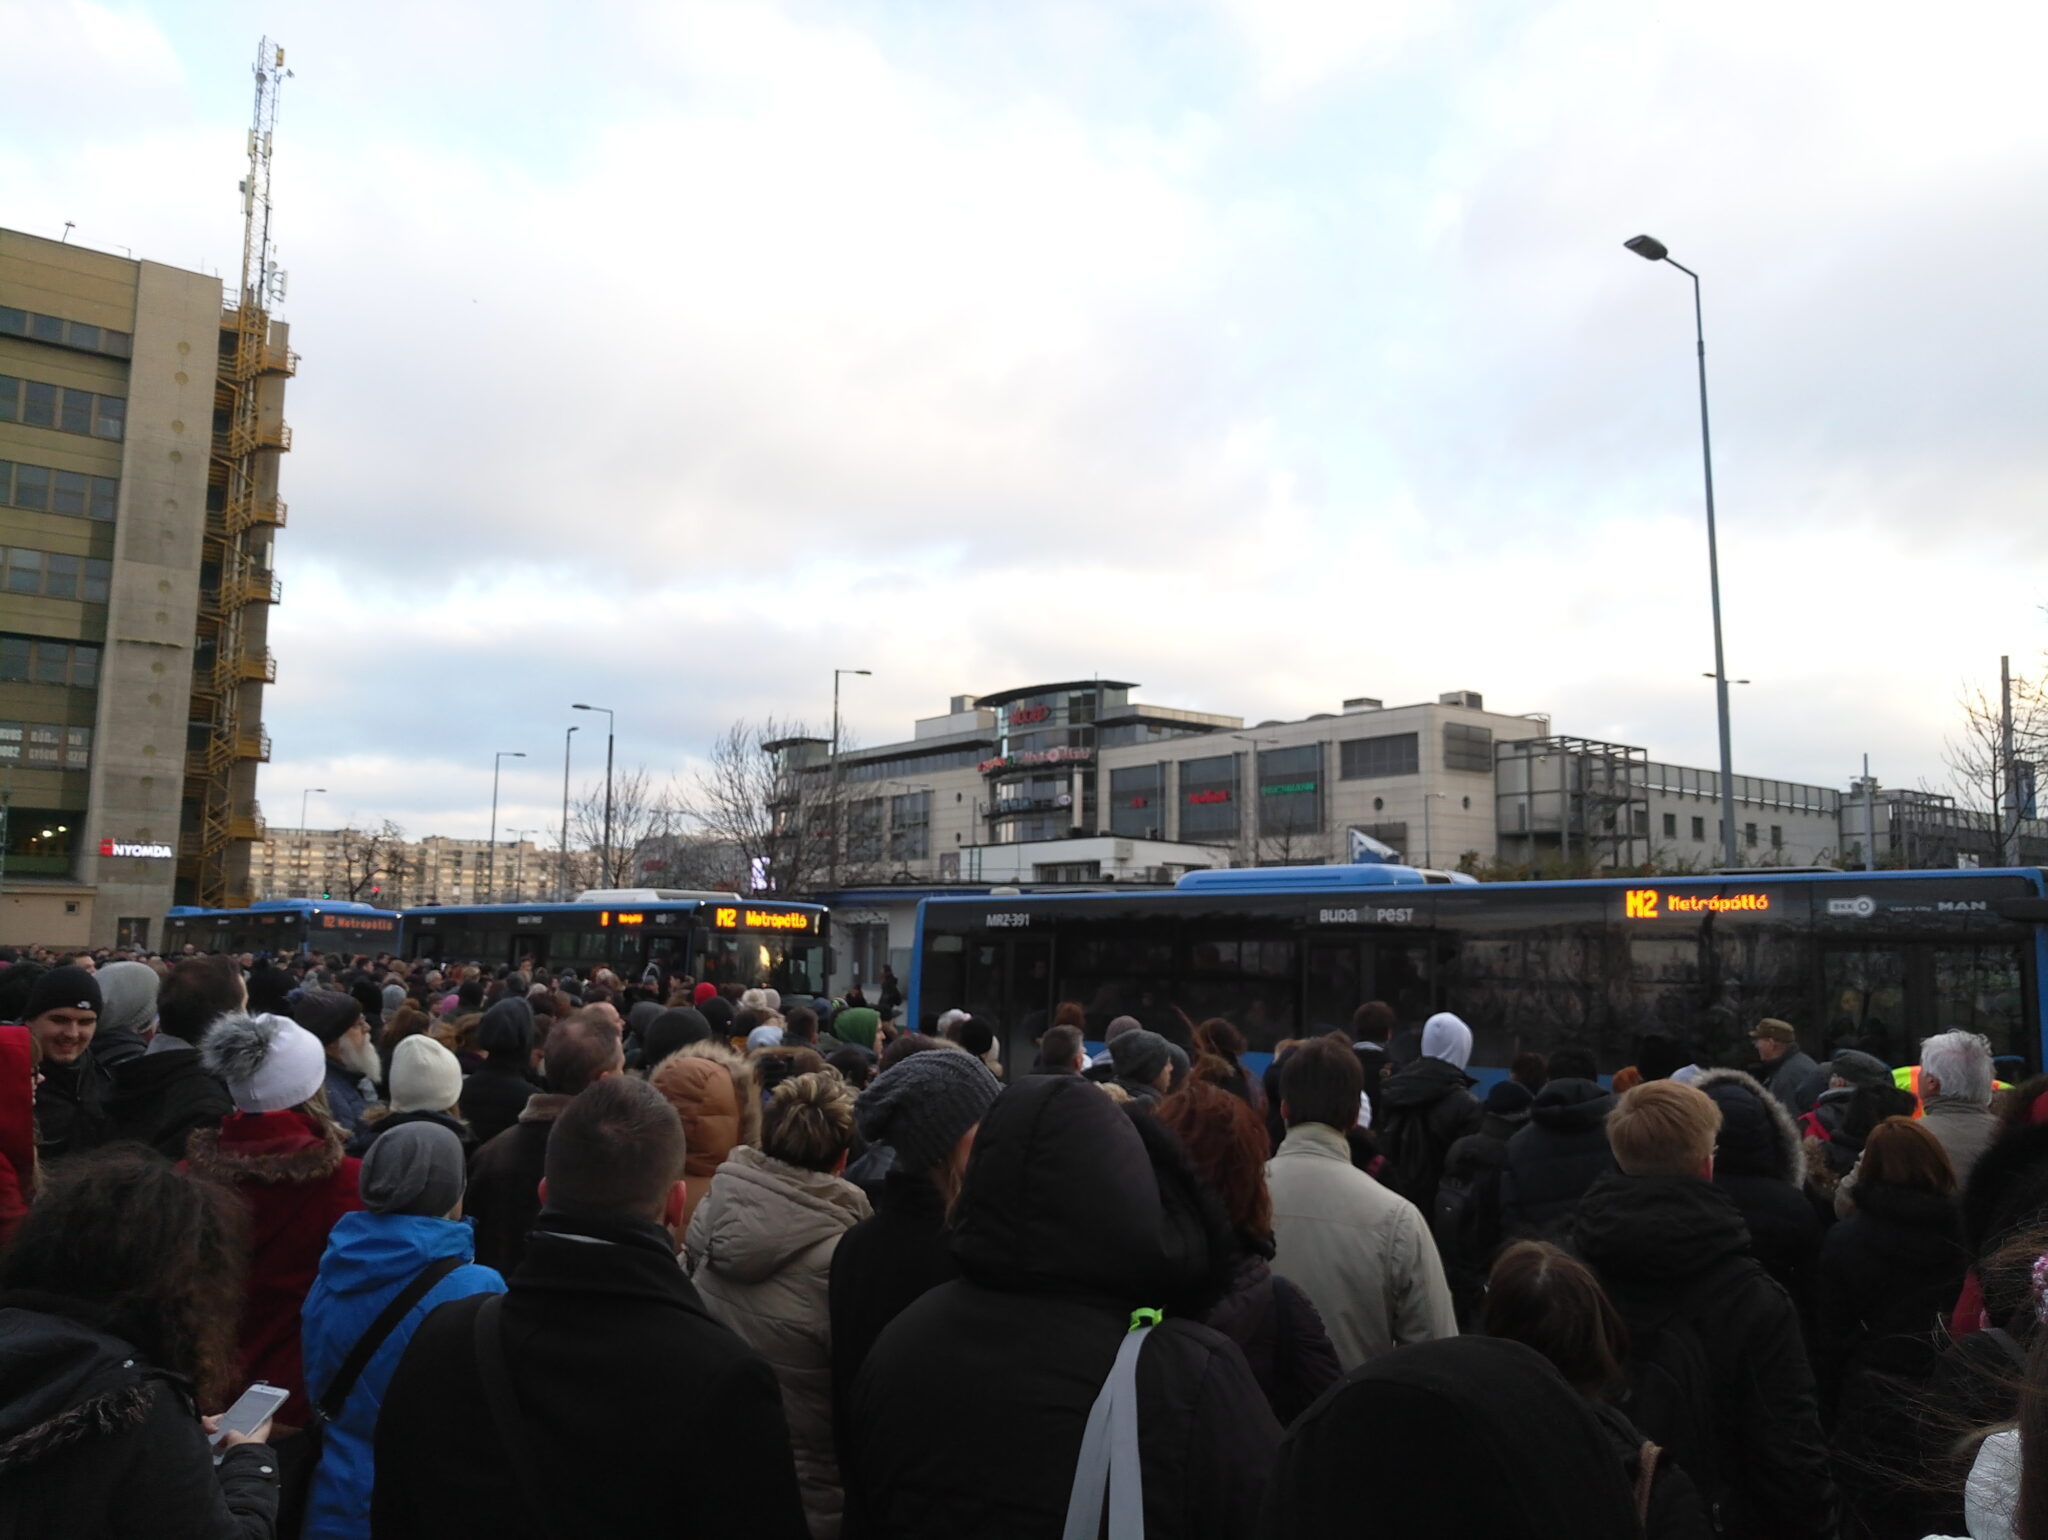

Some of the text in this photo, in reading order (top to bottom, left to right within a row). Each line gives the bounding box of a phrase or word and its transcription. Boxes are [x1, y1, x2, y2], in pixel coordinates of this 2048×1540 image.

[112, 844, 172, 858] NYOMDA
[1626, 889, 1659, 918] M2
[1938, 901, 1987, 911] MAN
[716, 908, 737, 927] M2
[986, 912, 1030, 927] MRZ-391
